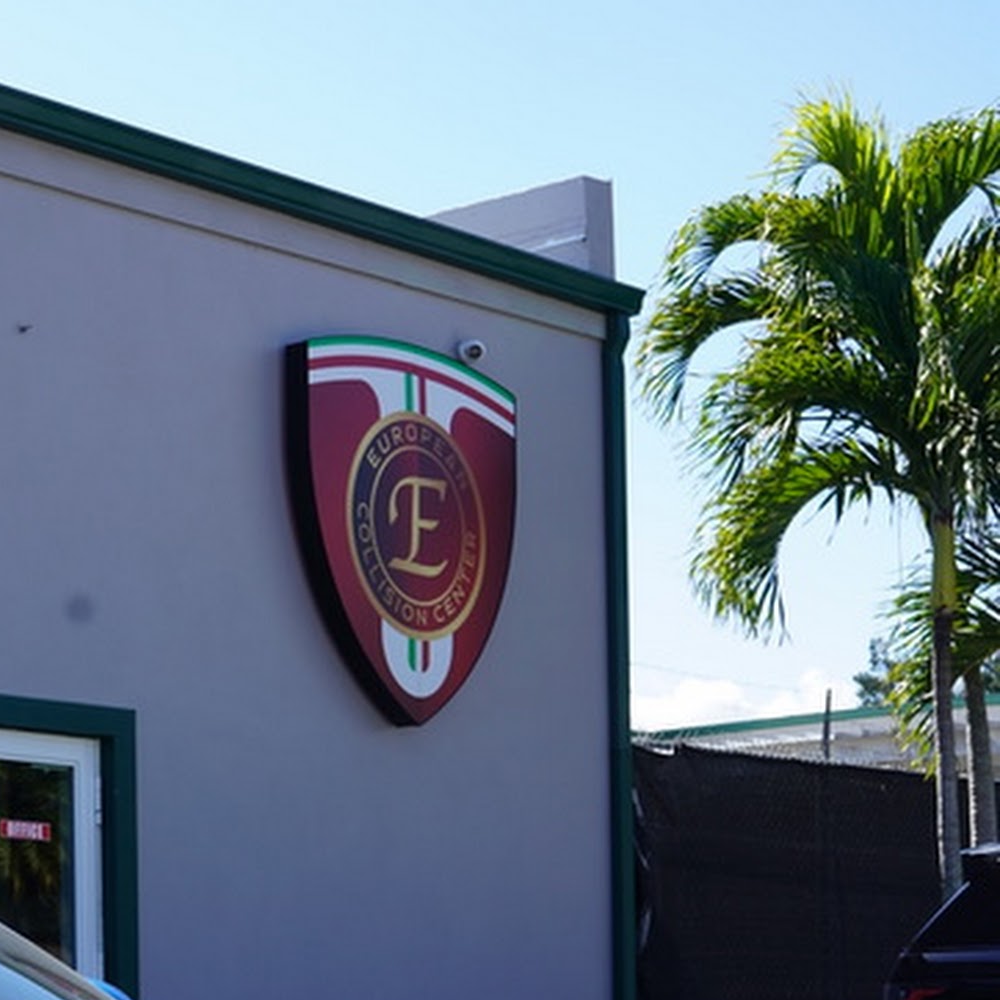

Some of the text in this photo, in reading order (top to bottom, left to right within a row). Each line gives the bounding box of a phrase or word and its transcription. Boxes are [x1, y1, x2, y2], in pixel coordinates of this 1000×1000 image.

[366, 422, 469, 490] EUROPEAN
[356, 502, 477, 626] COLLISION CENTER
[7, 820, 43, 840] OFFICE
